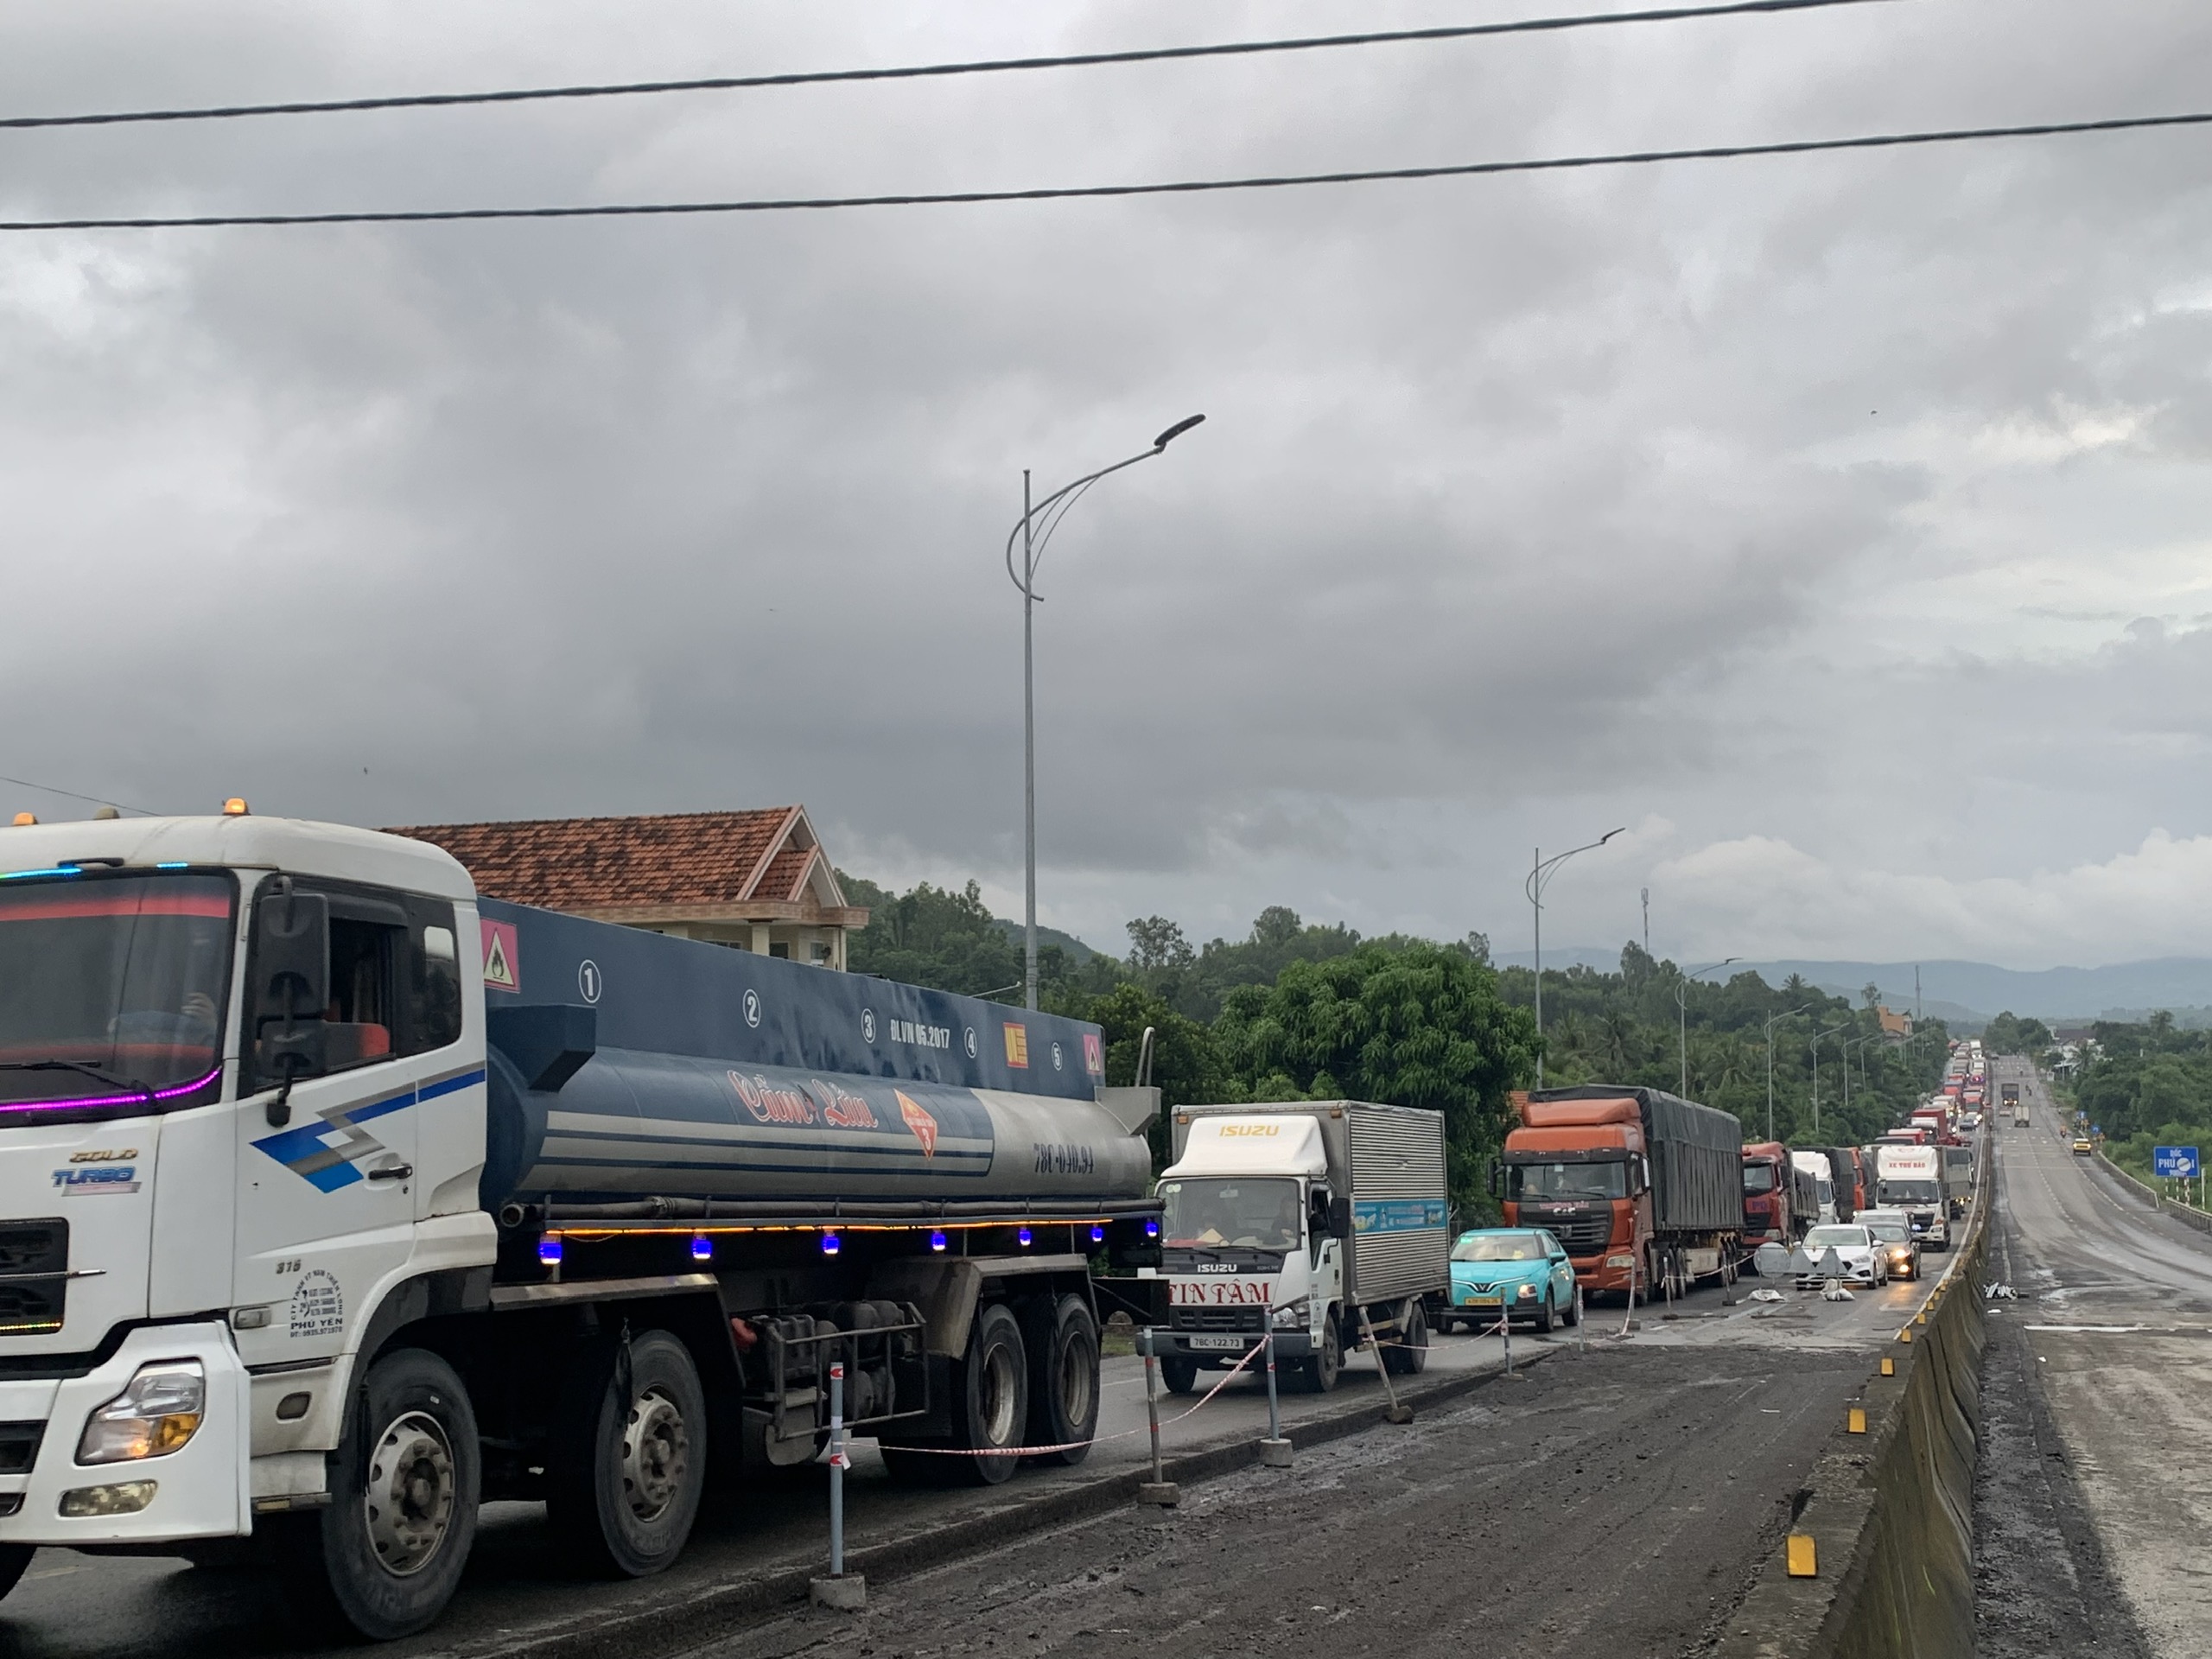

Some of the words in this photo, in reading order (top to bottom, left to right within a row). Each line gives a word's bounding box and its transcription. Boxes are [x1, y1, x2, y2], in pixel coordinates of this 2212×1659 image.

[584, 968, 594, 996] 1
[747, 995, 758, 1022] 2
[864, 1014, 874, 1038] 3
[921, 1128, 931, 1151] 3
[1218, 1125, 1280, 1137] ISUZU
[52, 1165, 135, 1187] TURBO
[276, 1259, 302, 1274] 315
[1197, 1264, 1237, 1273] ISUZU
[1211, 1278, 1271, 1304] TÂM
[320, 1318, 343, 1329] YÊN
